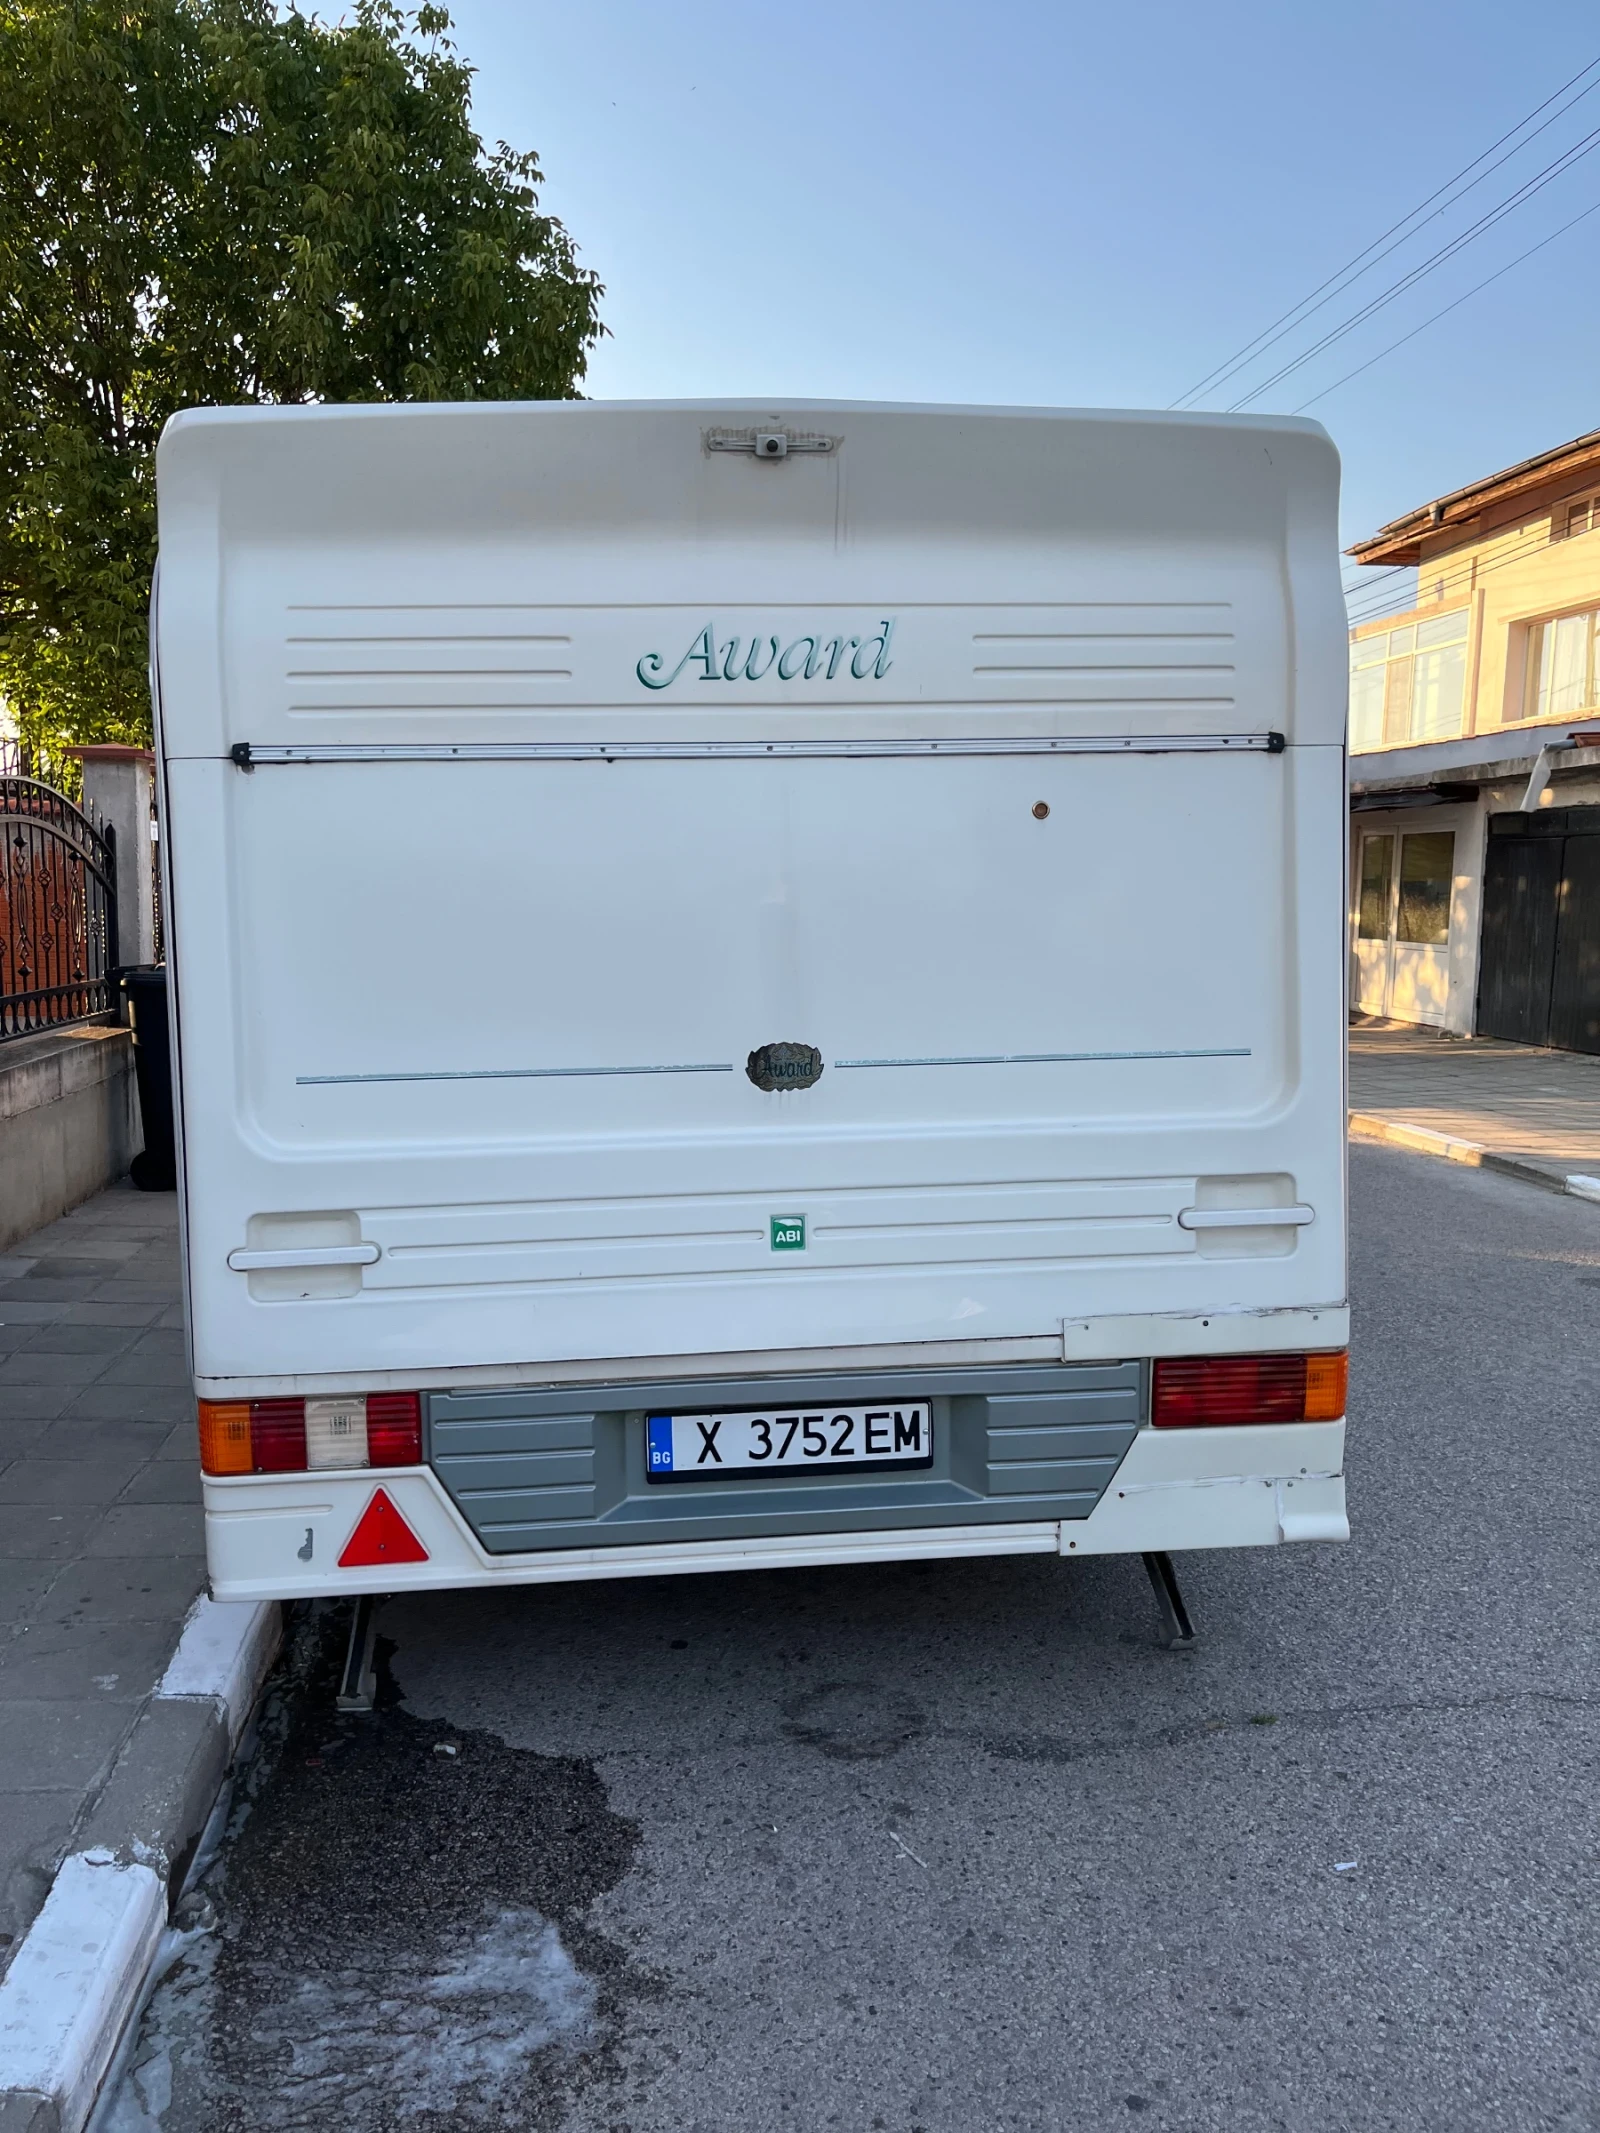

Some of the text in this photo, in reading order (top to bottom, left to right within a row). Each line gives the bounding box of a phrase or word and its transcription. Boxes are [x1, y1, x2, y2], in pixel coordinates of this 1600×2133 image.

[636, 616, 897, 690] Award
[776, 1230, 801, 1242] ABI
[696, 1421, 723, 1464] X
[652, 1452, 671, 1465] BG
